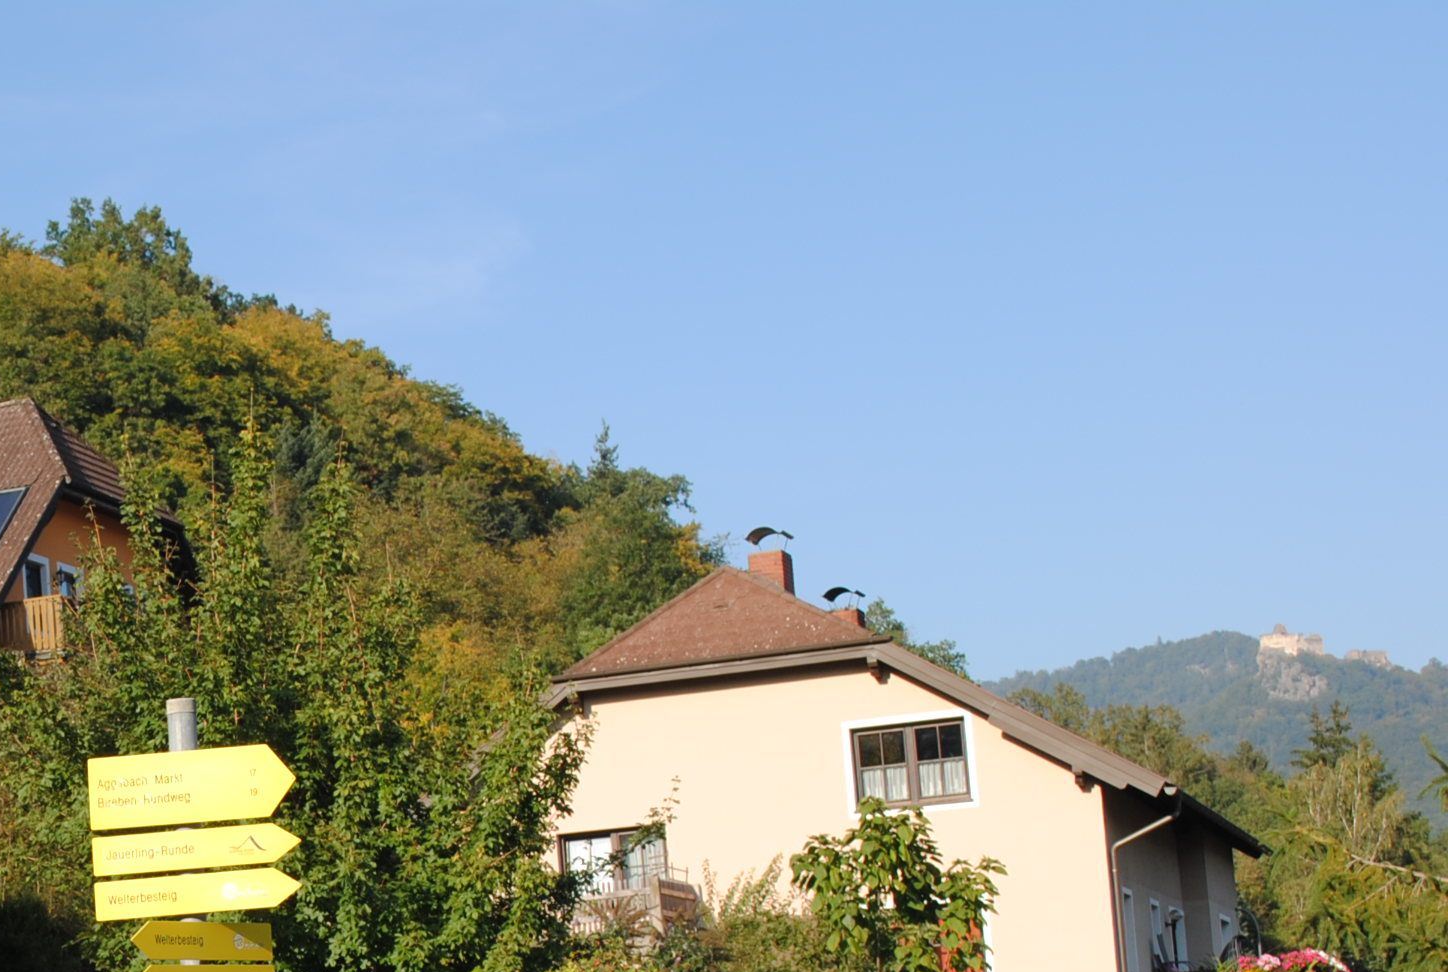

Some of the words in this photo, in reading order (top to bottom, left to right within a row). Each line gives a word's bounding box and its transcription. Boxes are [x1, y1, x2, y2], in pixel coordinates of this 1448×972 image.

[155, 773, 183, 784] Markt
[251, 787, 258, 796] 19
[106, 844, 194, 860] Jauerling-Runde
[108, 891, 177, 904] Welterbesteig
[155, 934, 204, 947] Welterbesteig
